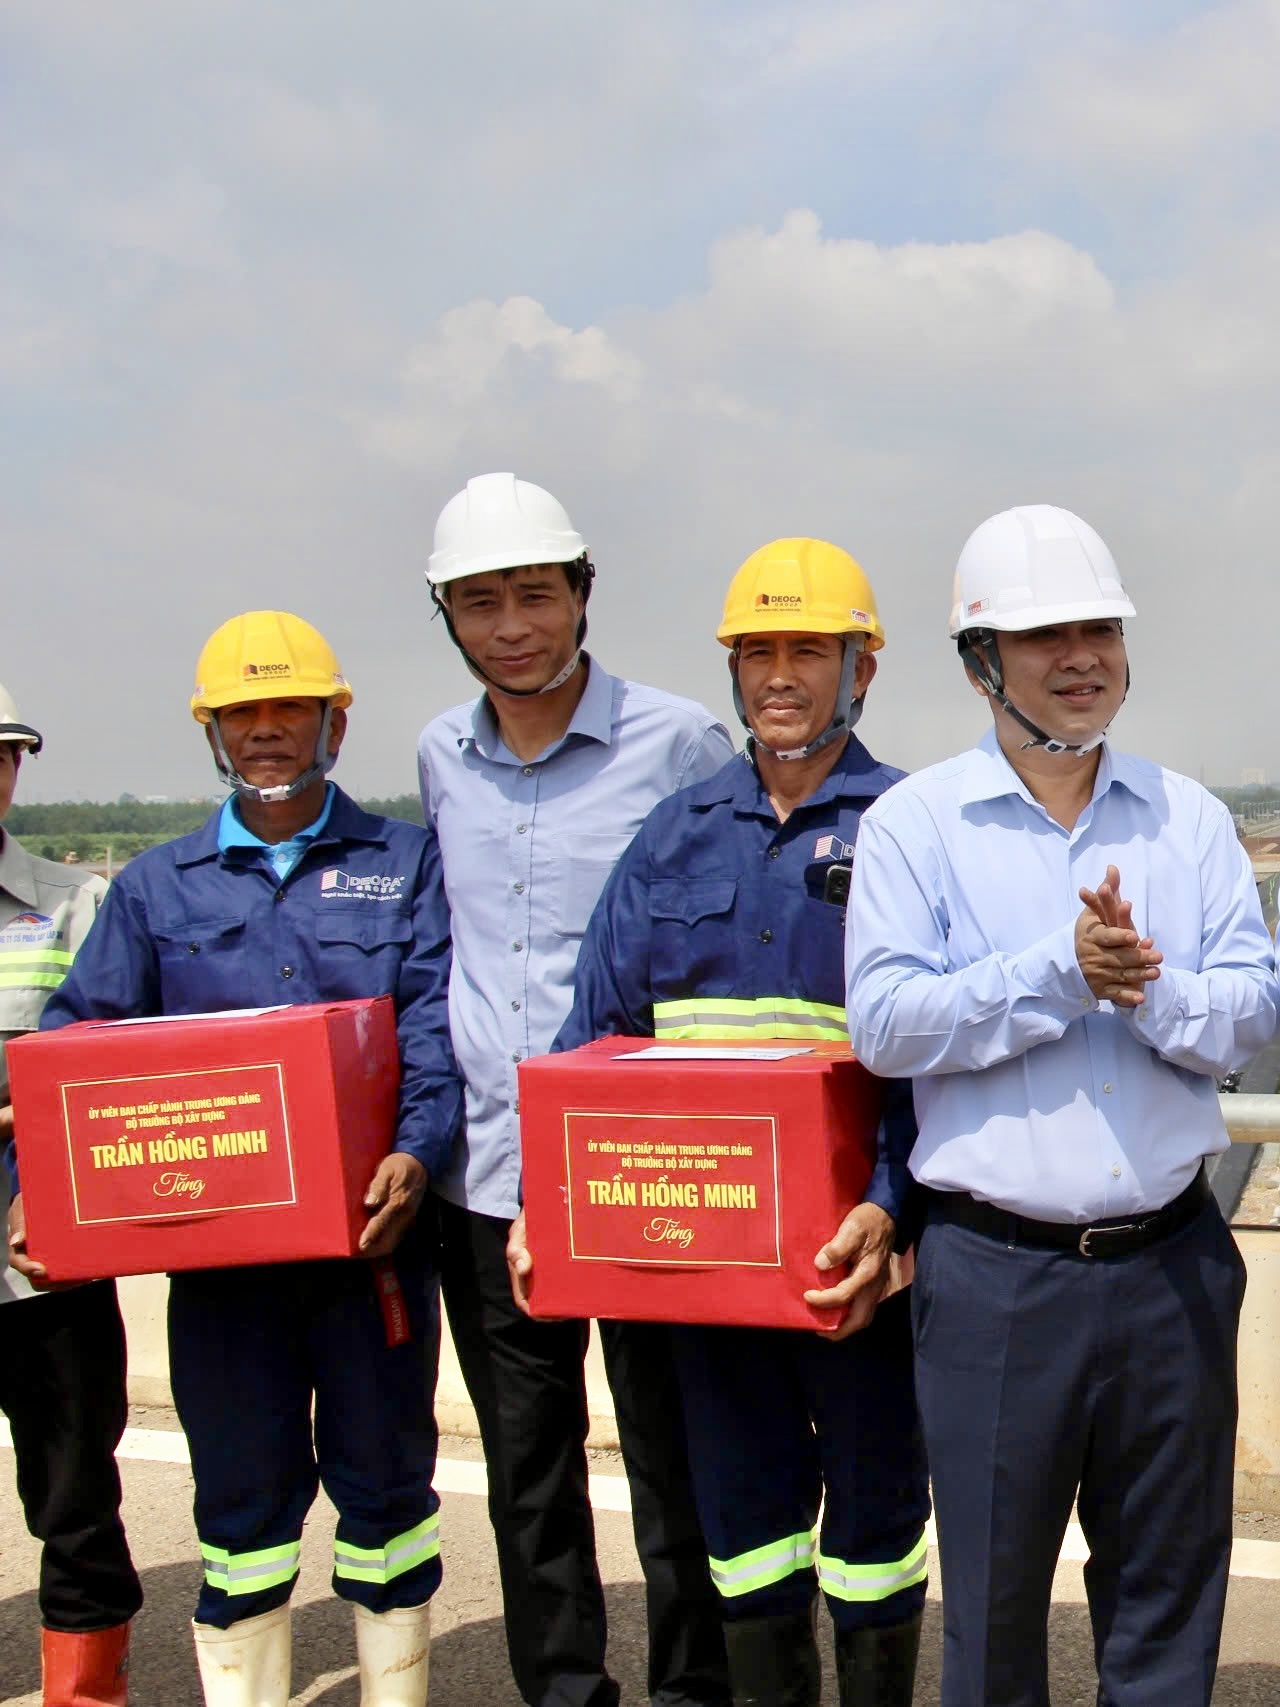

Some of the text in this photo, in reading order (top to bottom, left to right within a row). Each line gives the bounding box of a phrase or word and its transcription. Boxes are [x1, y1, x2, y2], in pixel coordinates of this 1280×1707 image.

[771, 595, 802, 603] DEOCA
[259, 663, 290, 672] DEOCA
[350, 875, 401, 888] DEOCA
[356, 885, 395, 893] GROUP
[88, 1092, 261, 1120] ỦY VIÊN BAN CHẤP HÀNH TRUNG ƯƠNG ĐẢNG
[125, 1117, 138, 1131] BỘ
[172, 1112, 183, 1127] BỘ
[184, 1112, 200, 1124] XÂY
[201, 1110, 226, 1124] DỰNG
[89, 1130, 268, 1169] TRẦN HỒNG MINH
[588, 1140, 752, 1156] ỦY VIÊN BAN CHẤP HÀNH TRUNG ƯƠNG ĐẢNG
[621, 1157, 632, 1170] BỘ
[665, 1156, 677, 1171] BỘ
[678, 1156, 693, 1169] XÂY
[695, 1159, 717, 1171] DỰNG
[153, 1172, 205, 1199] Tặng
[587, 1173, 756, 1209] TRẦN HỒNG MINH
[644, 1217, 695, 1248] Tặng
